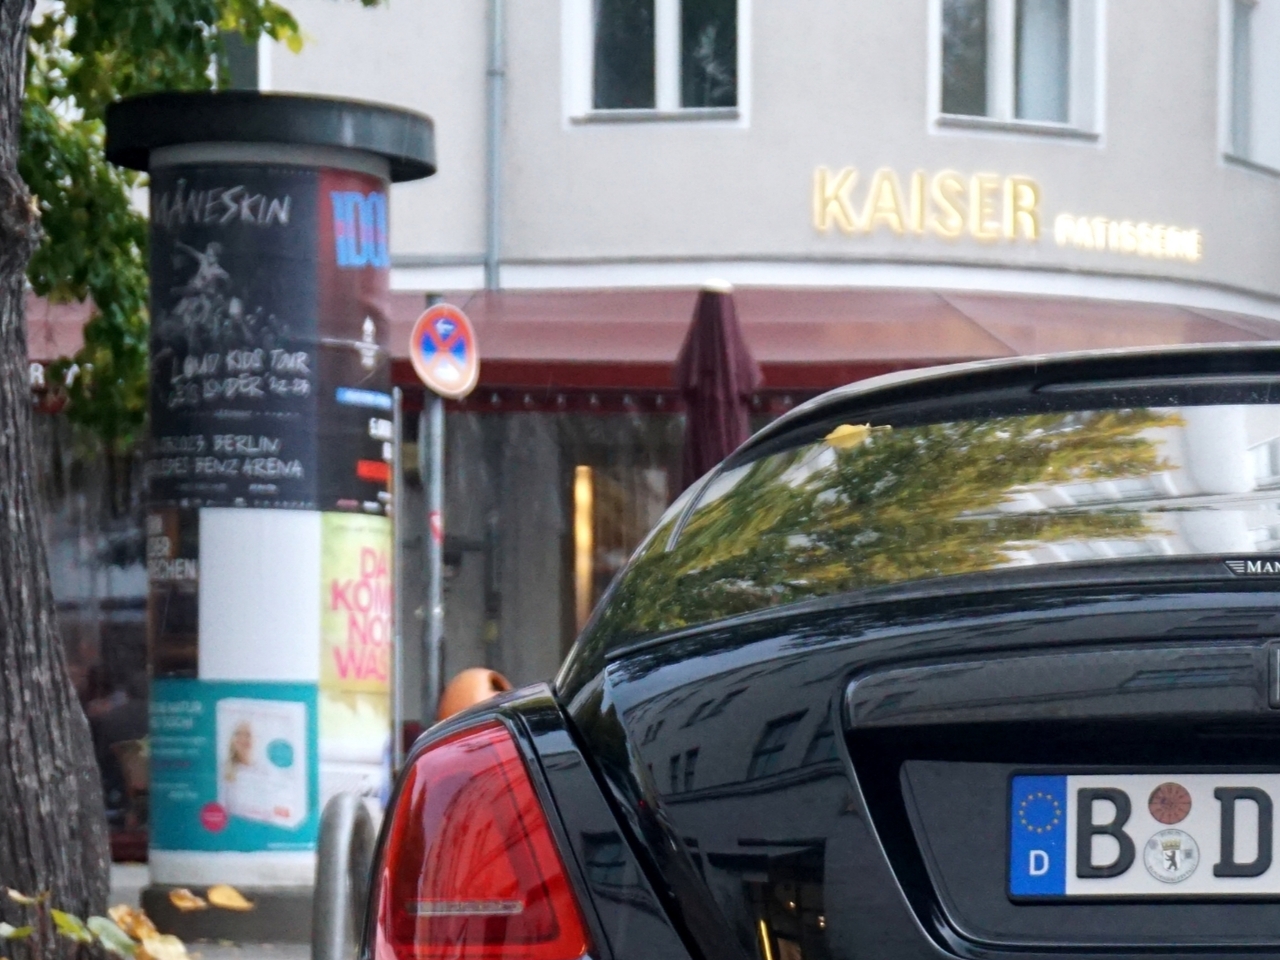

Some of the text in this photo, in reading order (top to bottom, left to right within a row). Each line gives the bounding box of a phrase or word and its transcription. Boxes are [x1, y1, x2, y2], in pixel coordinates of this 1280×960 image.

[813, 167, 1040, 240] KAISER
[270, 349, 311, 374] TOUR
[213, 433, 280, 454] BERLIN
[242, 457, 304, 481] ARENA
[1029, 850, 1049, 876] D
[1076, 786, 1136, 878] B
